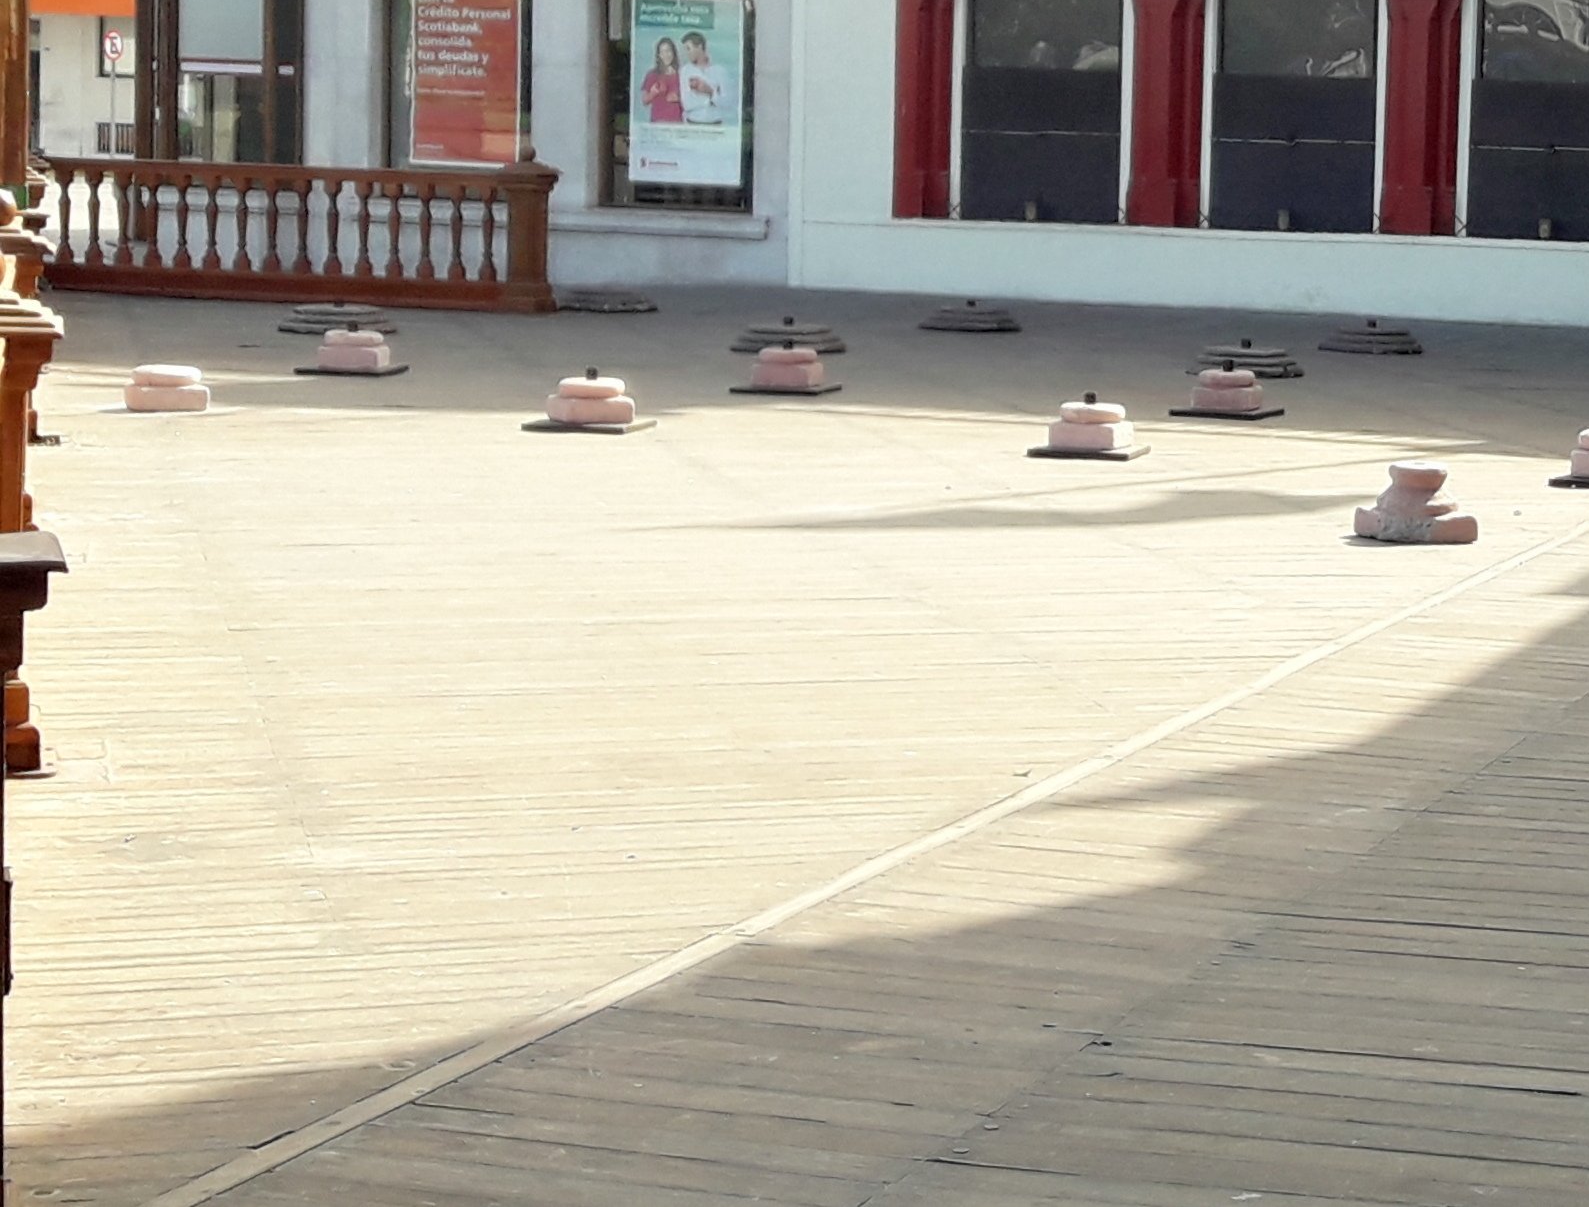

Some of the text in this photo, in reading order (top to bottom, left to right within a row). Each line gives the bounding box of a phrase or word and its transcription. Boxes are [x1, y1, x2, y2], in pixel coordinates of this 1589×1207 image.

[462, 7, 512, 20] Personal
[418, 36, 472, 47] consolida
[418, 50, 489, 65] tus deudas y
